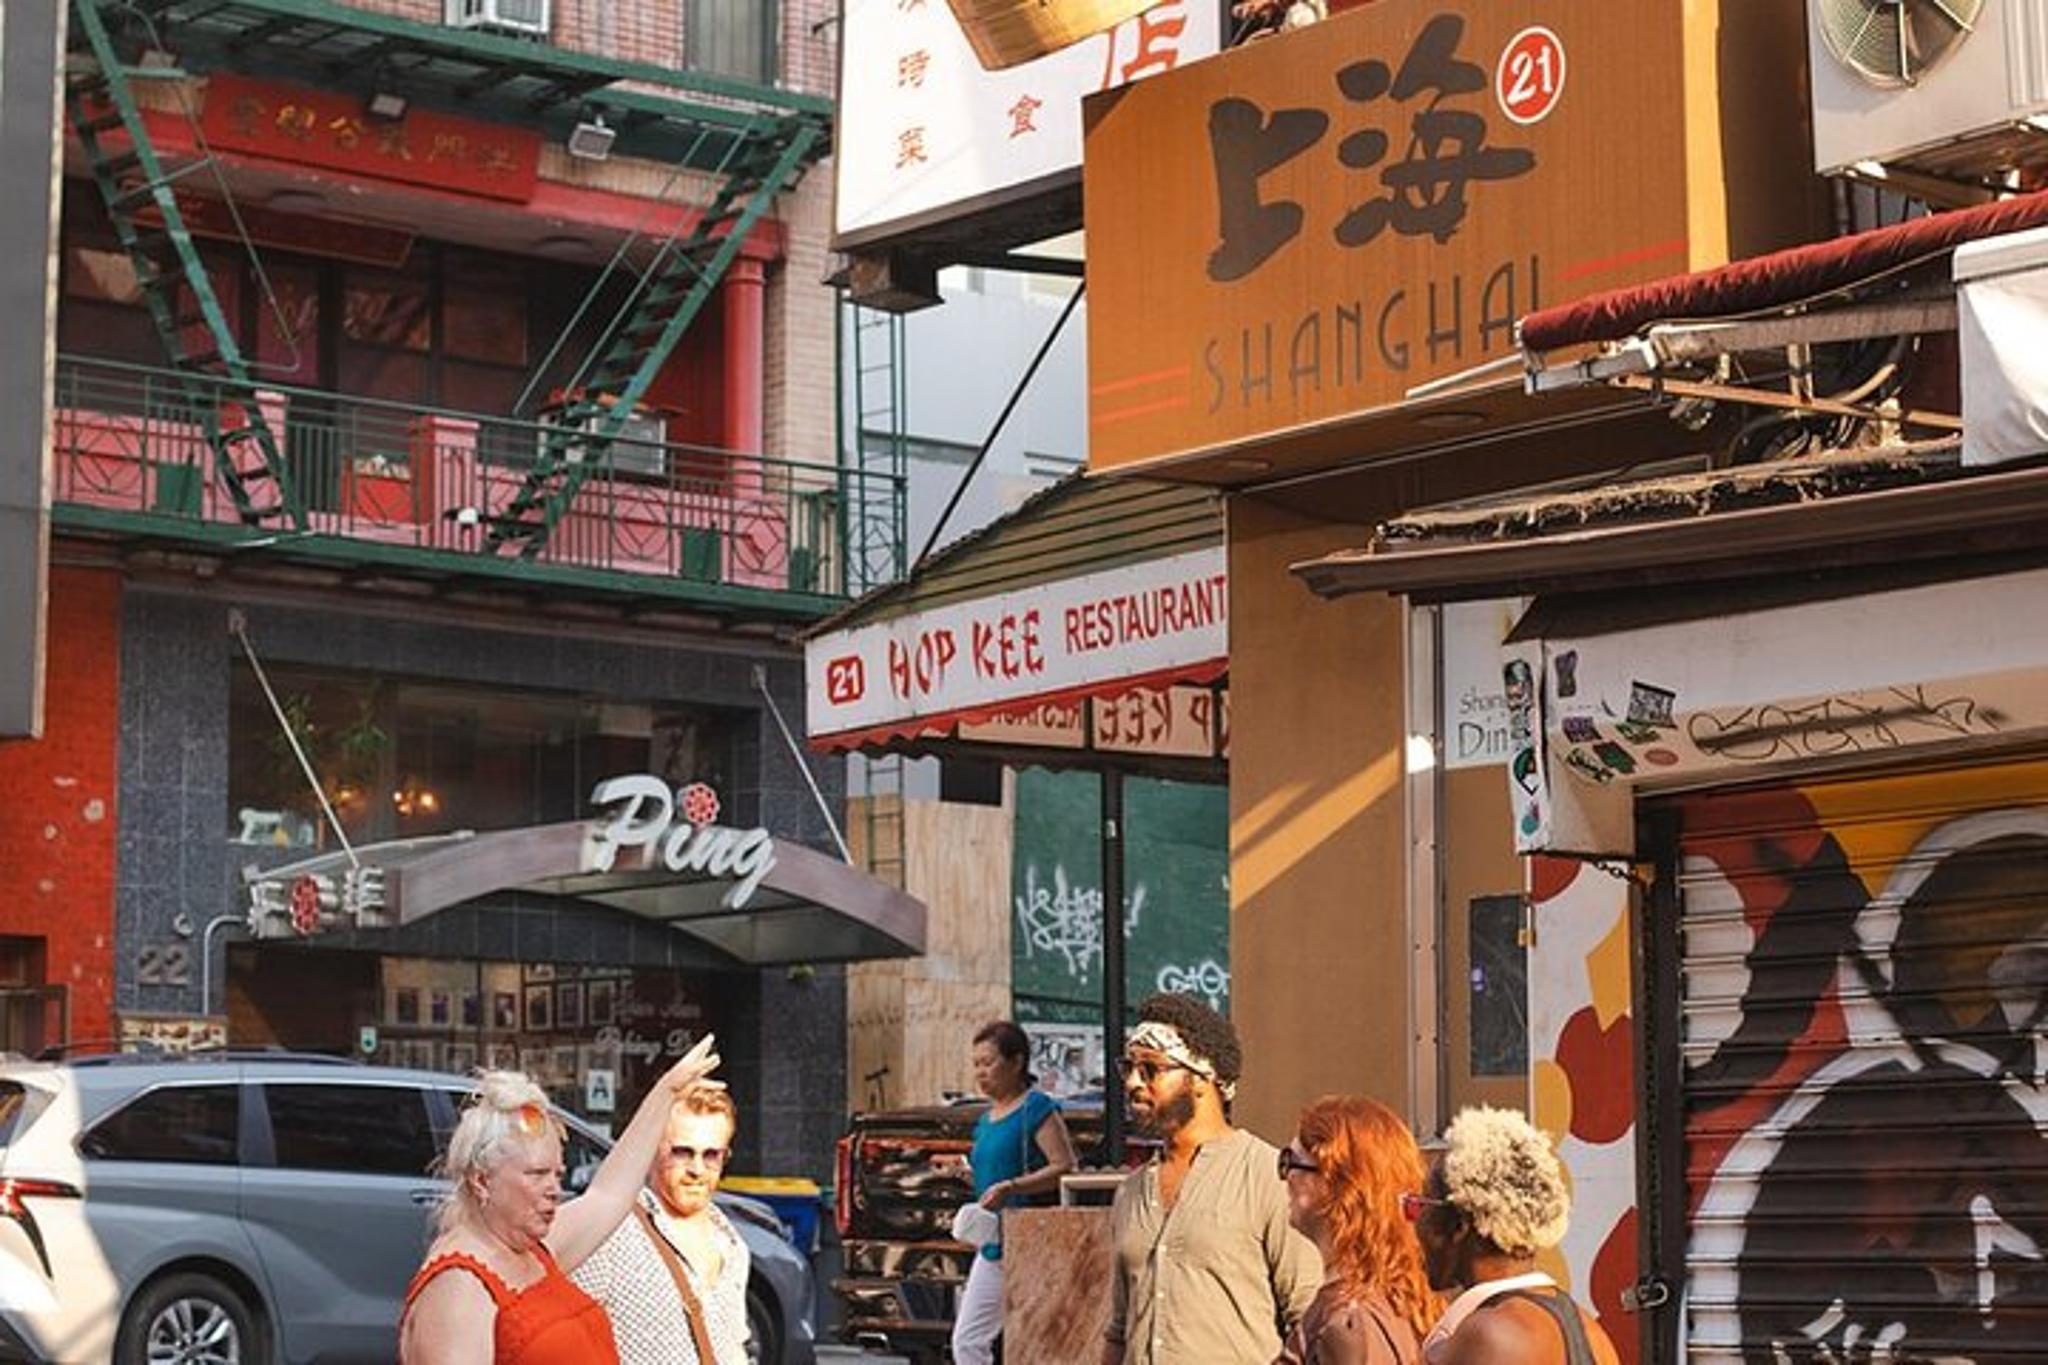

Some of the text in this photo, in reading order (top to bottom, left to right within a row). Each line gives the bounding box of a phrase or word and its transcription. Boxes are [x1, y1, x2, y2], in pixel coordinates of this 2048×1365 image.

[1506, 45, 1553, 105] 21
[1206, 13, 1536, 281] 上海
[1205, 255, 1541, 414] SHANGHAI
[832, 574, 1227, 699] 21 HOP KEE RESTAURANT
[590, 774, 777, 908] Ping
[138, 947, 189, 985] 22
[592, 1073, 609, 1099] A
